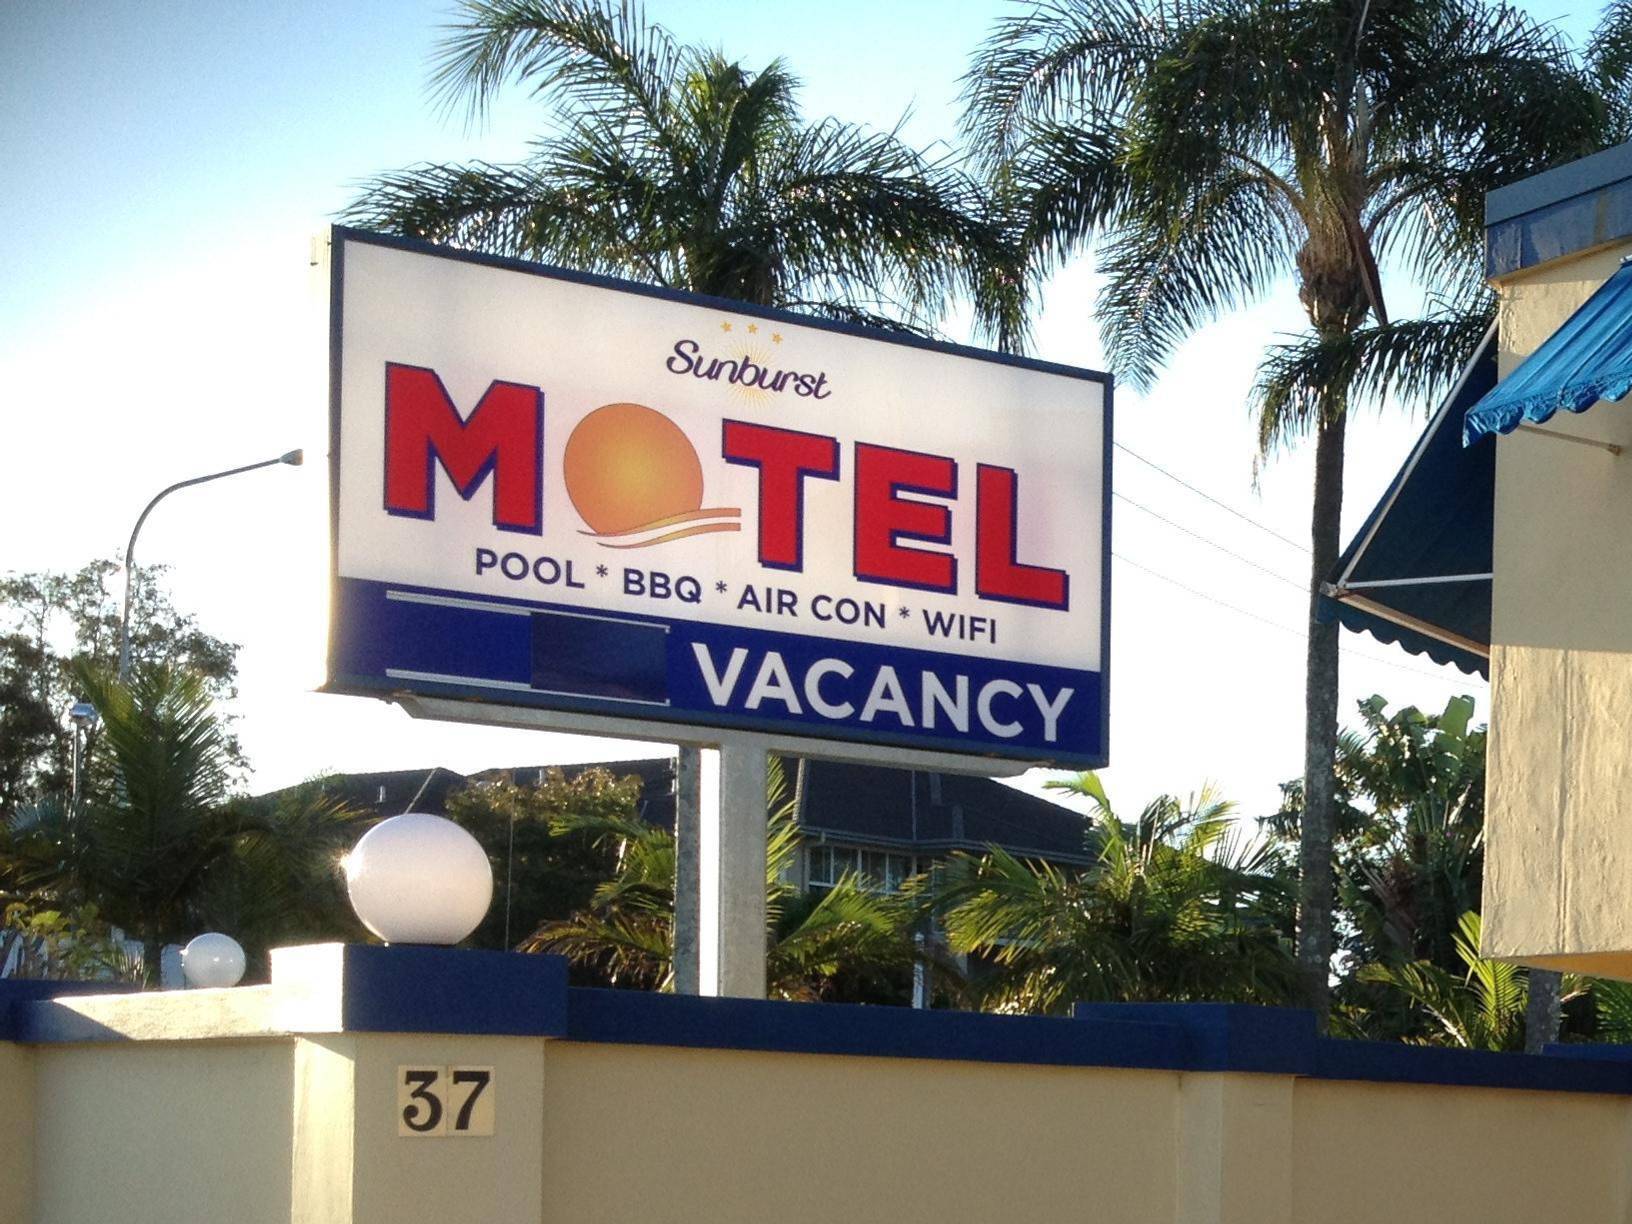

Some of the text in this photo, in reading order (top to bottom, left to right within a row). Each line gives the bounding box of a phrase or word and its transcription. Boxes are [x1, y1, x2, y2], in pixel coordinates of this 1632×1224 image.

[666, 339, 832, 399] Sunburst
[384, 361, 1070, 611] MOTEL
[475, 548, 997, 645] POOL BBQ AIR CON WIFI
[691, 643, 1075, 743] VACANCY
[402, 1070, 491, 1133] 37
